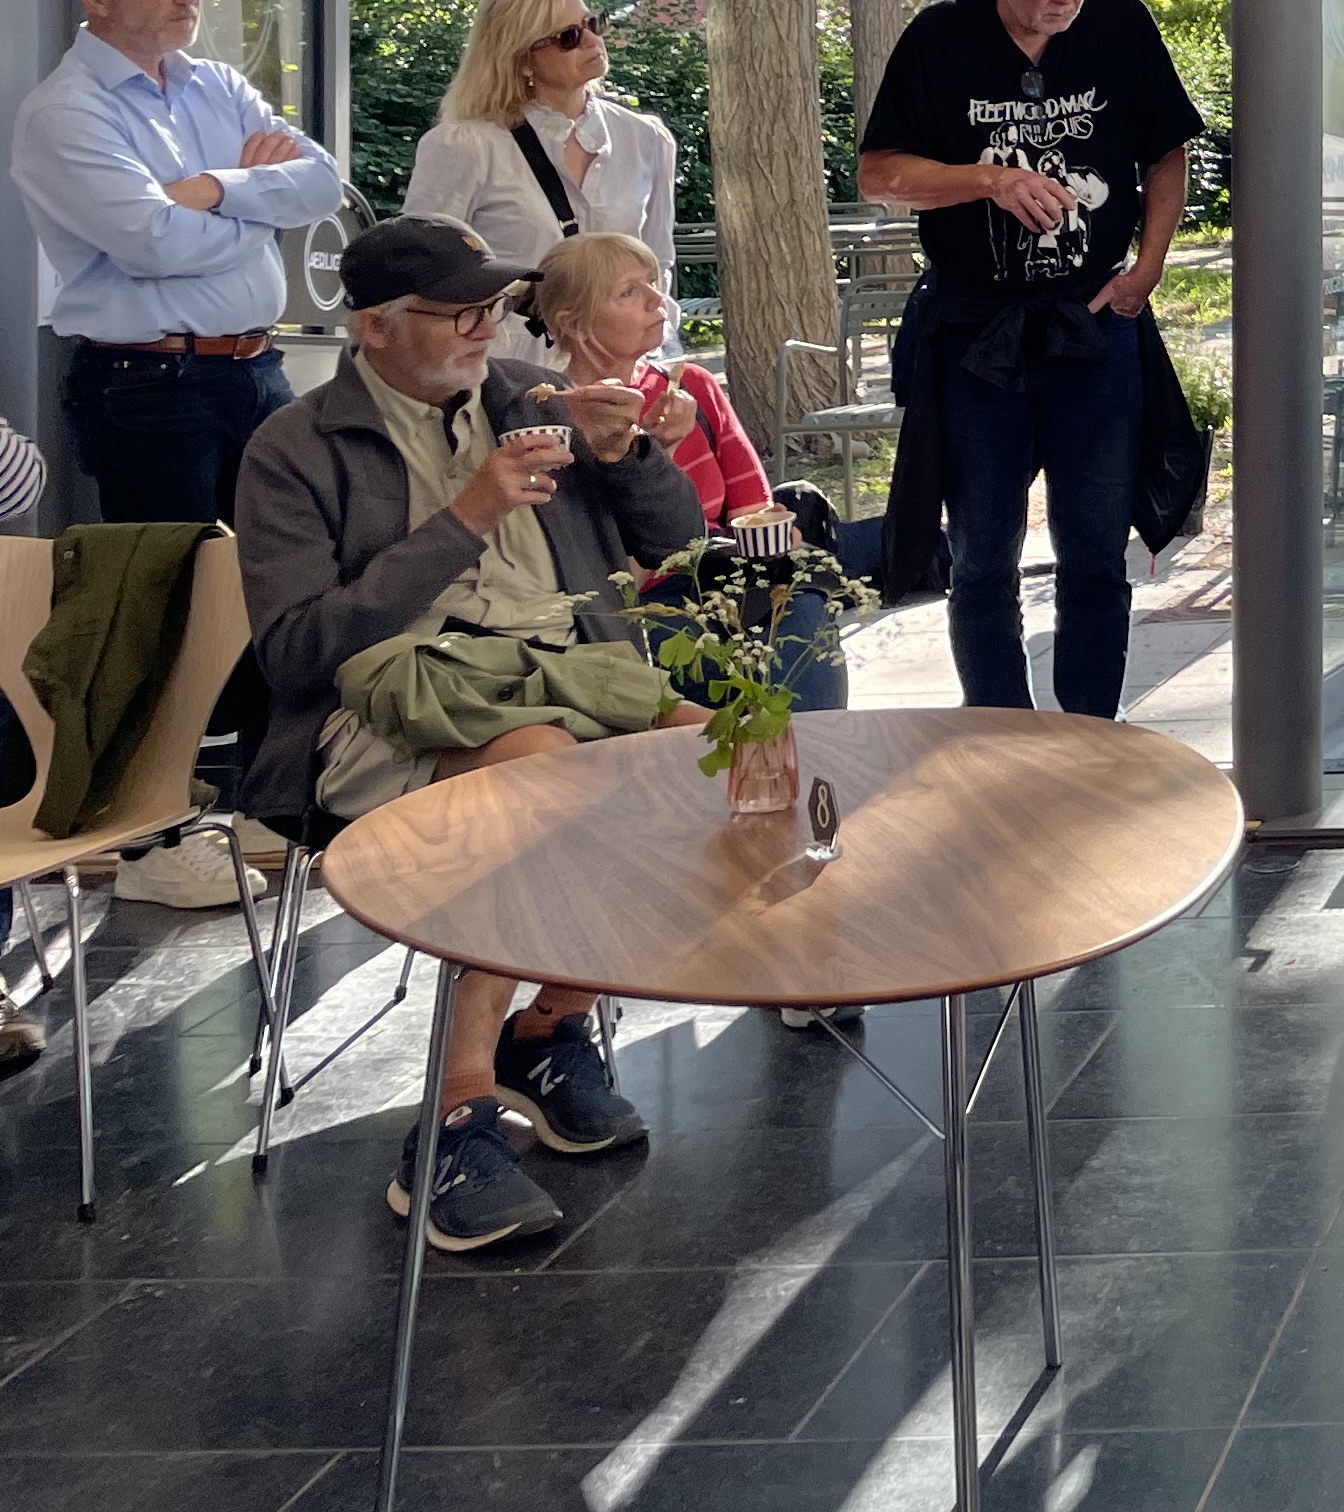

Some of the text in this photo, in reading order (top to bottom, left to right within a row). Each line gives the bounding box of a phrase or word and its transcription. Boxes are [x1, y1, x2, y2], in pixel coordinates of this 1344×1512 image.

[1060, 87, 1108, 112] MAC
[308, 251, 342, 272] ÆRLIG
[817, 784, 830, 829] 8
